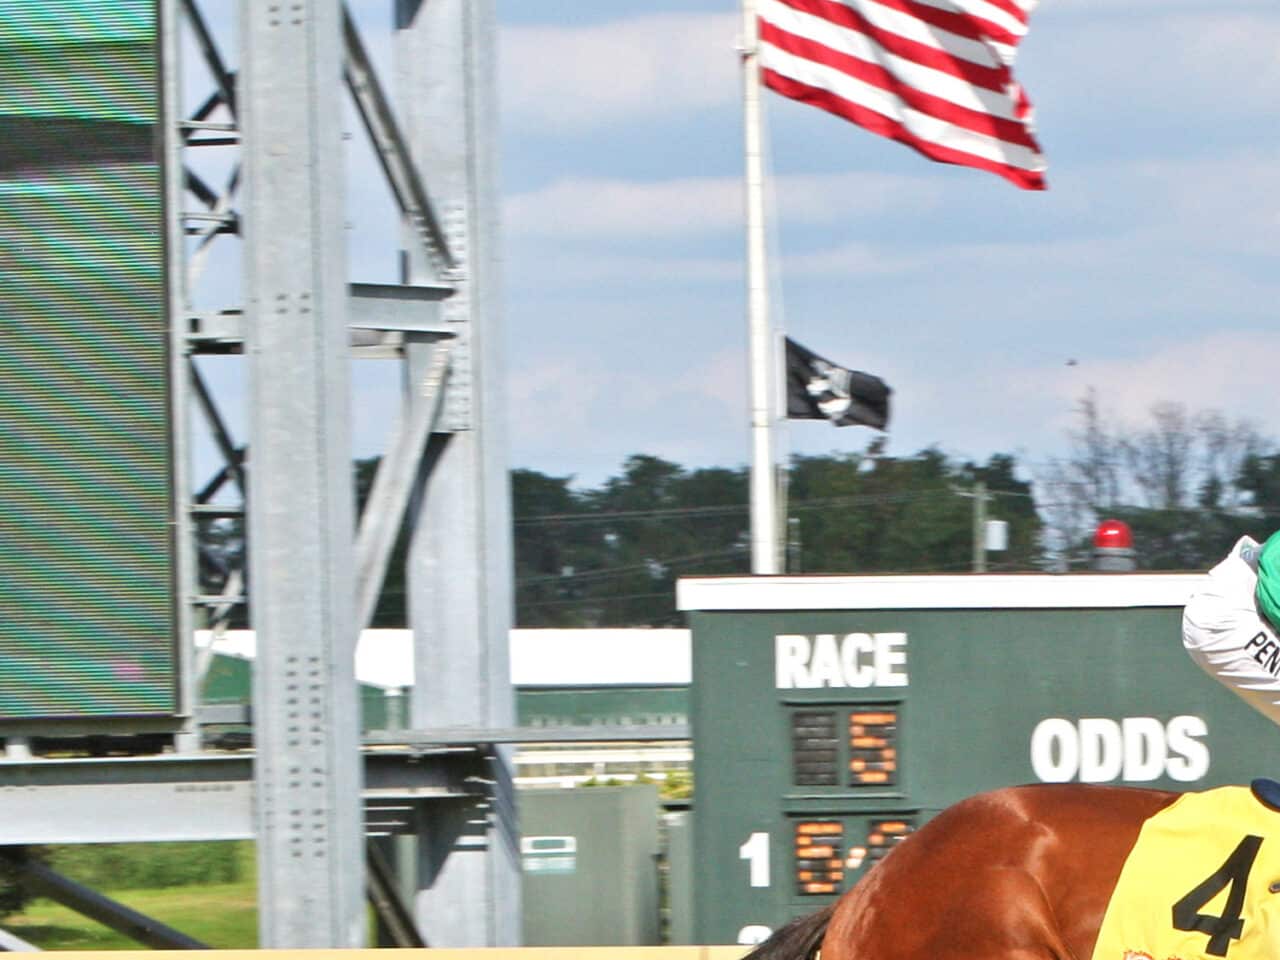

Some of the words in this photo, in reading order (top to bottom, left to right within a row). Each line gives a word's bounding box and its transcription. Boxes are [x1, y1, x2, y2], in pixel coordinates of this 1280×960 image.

[775, 632, 909, 689] RACE
[849, 711, 897, 783] 5
[1030, 715, 1211, 783] ODDS
[739, 831, 771, 888] 1
[1171, 834, 1265, 958] 4
